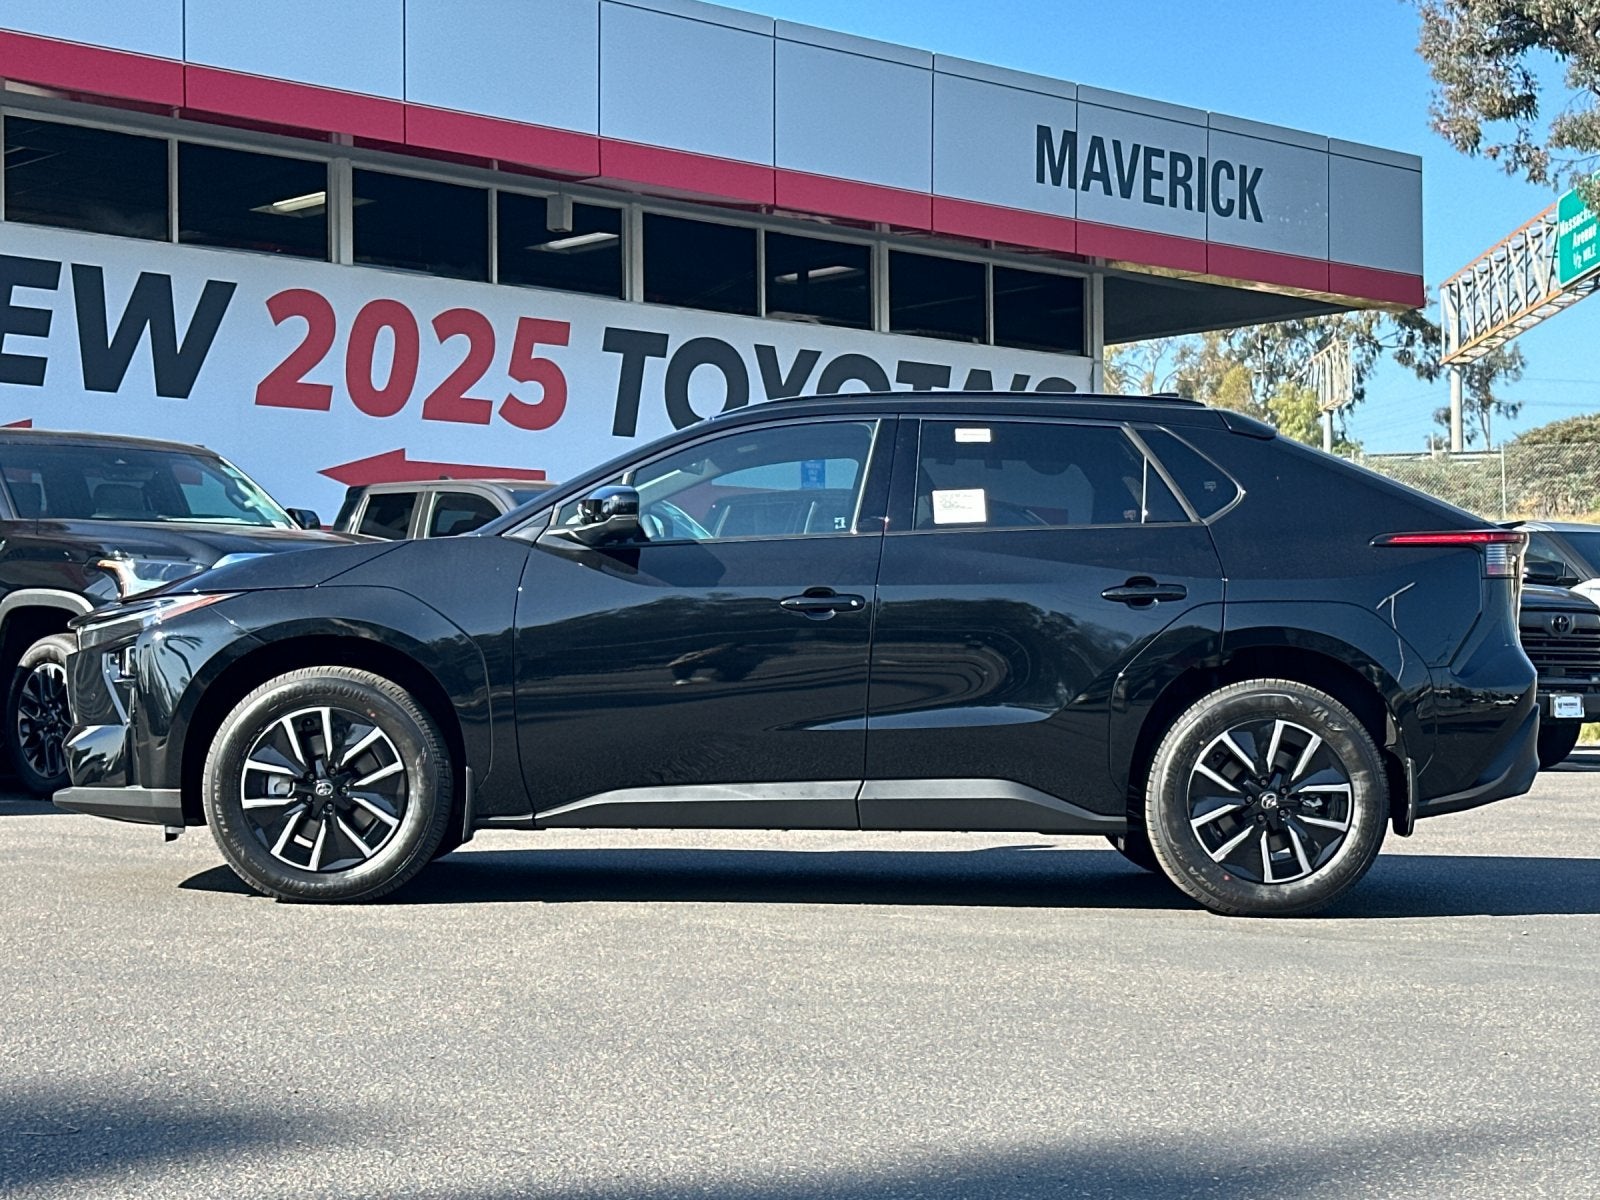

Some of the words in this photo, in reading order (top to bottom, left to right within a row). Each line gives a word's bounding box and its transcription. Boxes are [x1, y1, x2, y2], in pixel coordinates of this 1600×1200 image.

[1036, 124, 1264, 223] MAVERICK
[1582, 243, 1597, 263] MILE
[255, 288, 571, 431] 2025
